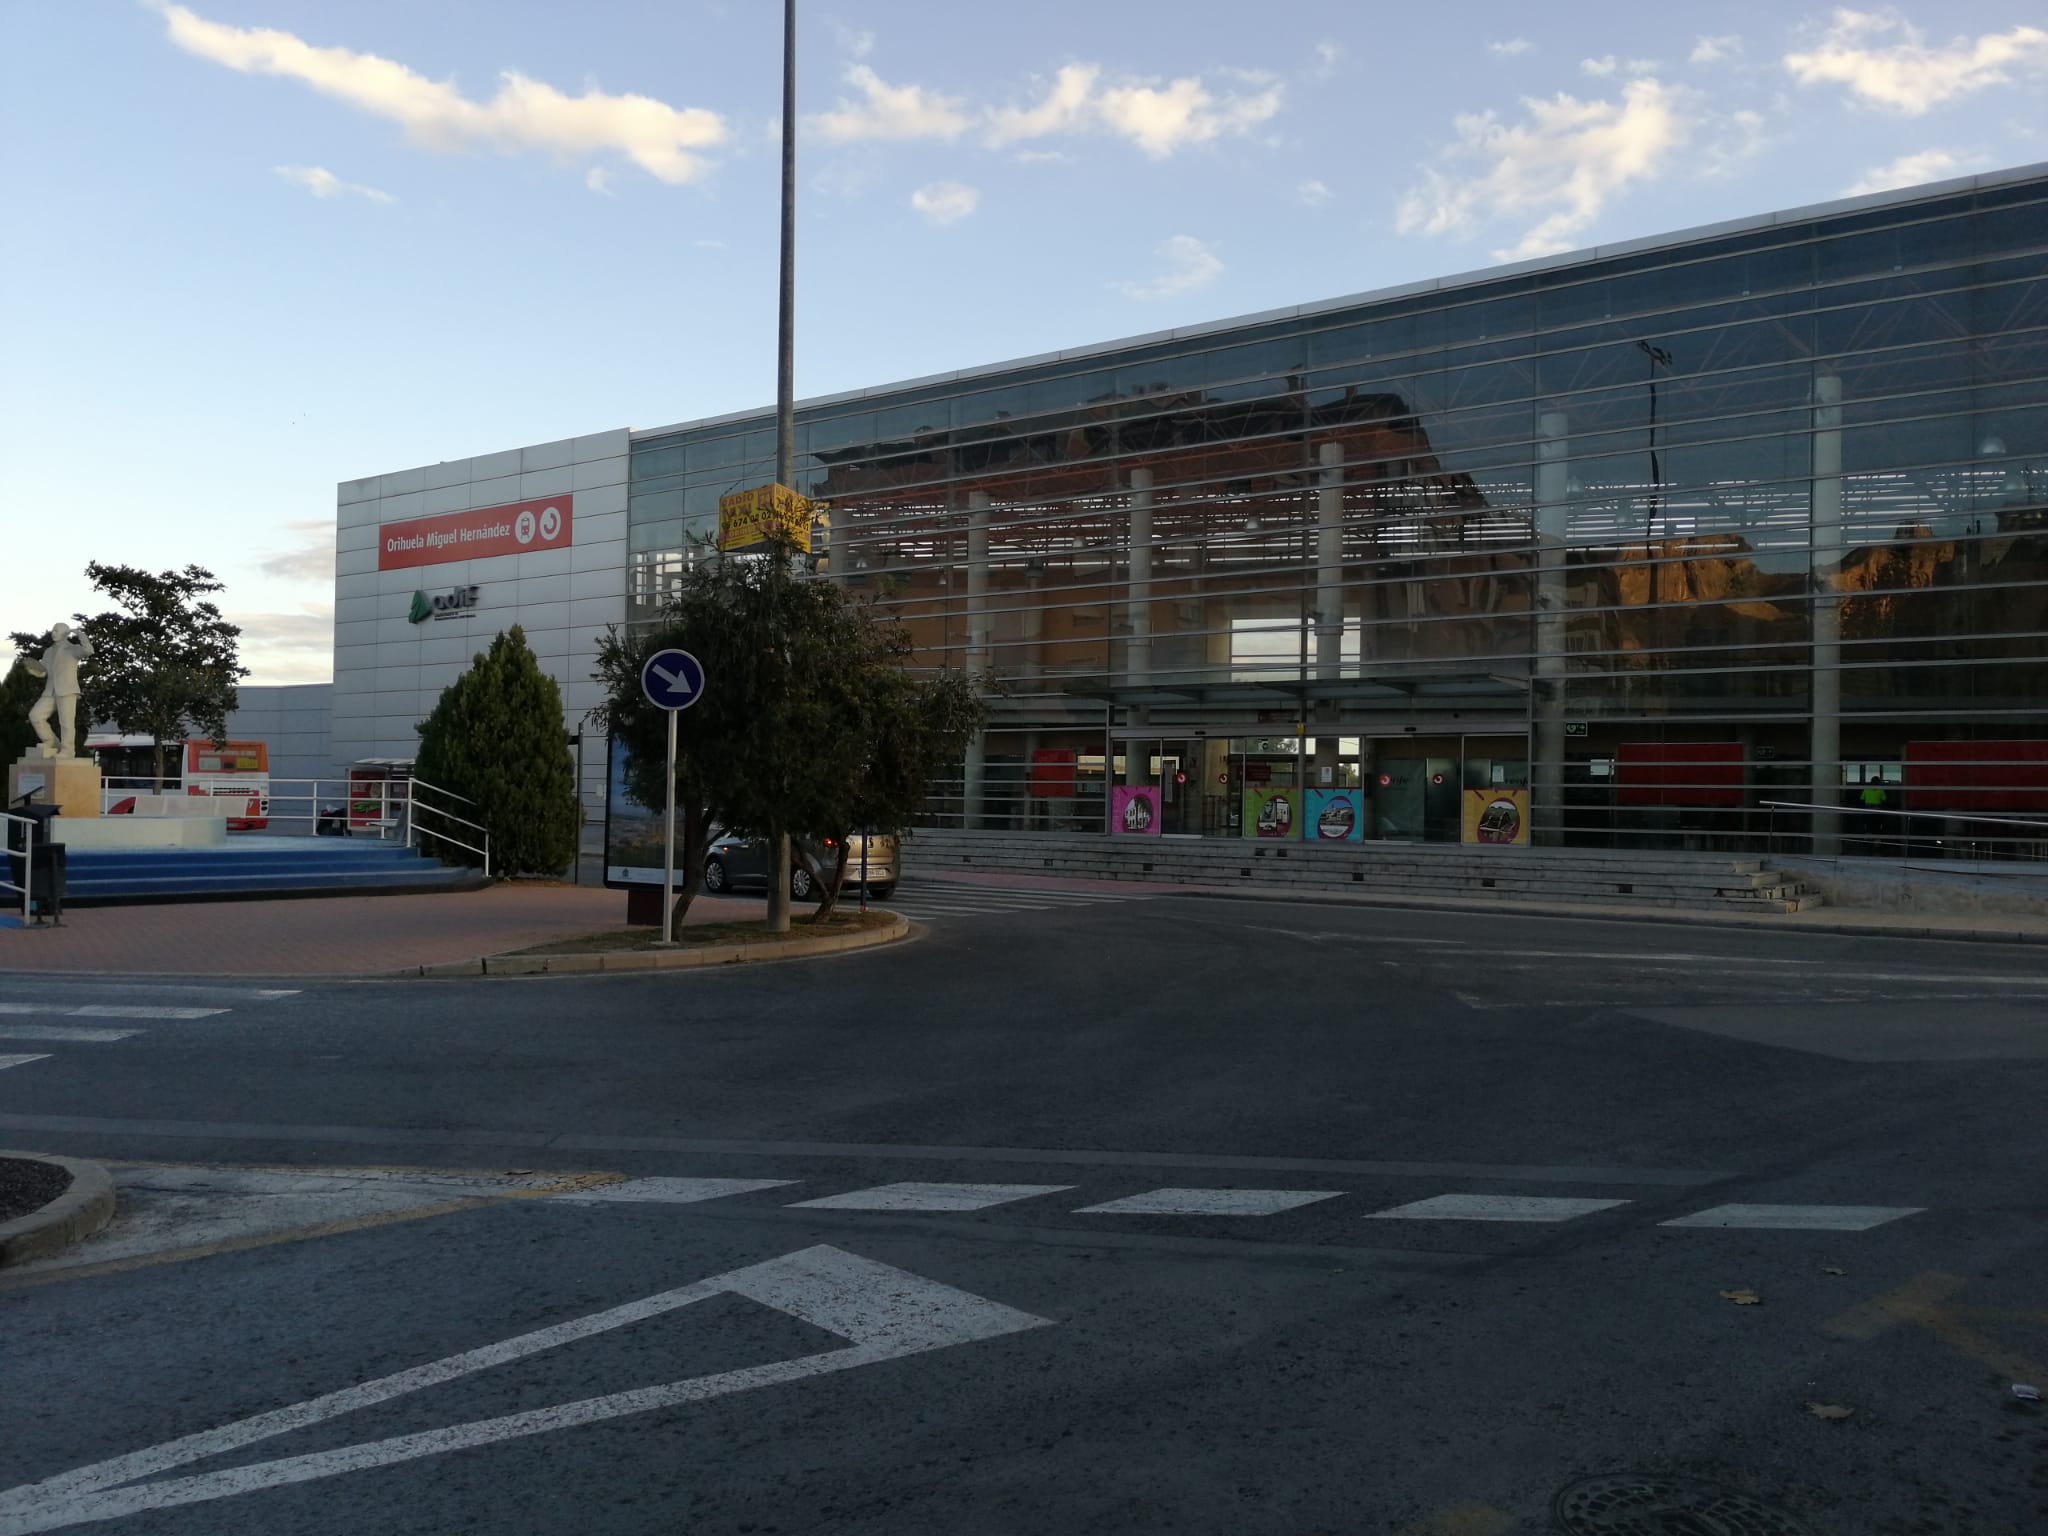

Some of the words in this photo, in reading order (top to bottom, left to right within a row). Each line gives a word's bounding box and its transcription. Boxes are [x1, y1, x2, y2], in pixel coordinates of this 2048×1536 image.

[387, 534, 424, 552] Orihuela
[426, 528, 457, 549] Miguel
[460, 523, 511, 542] Hernández
